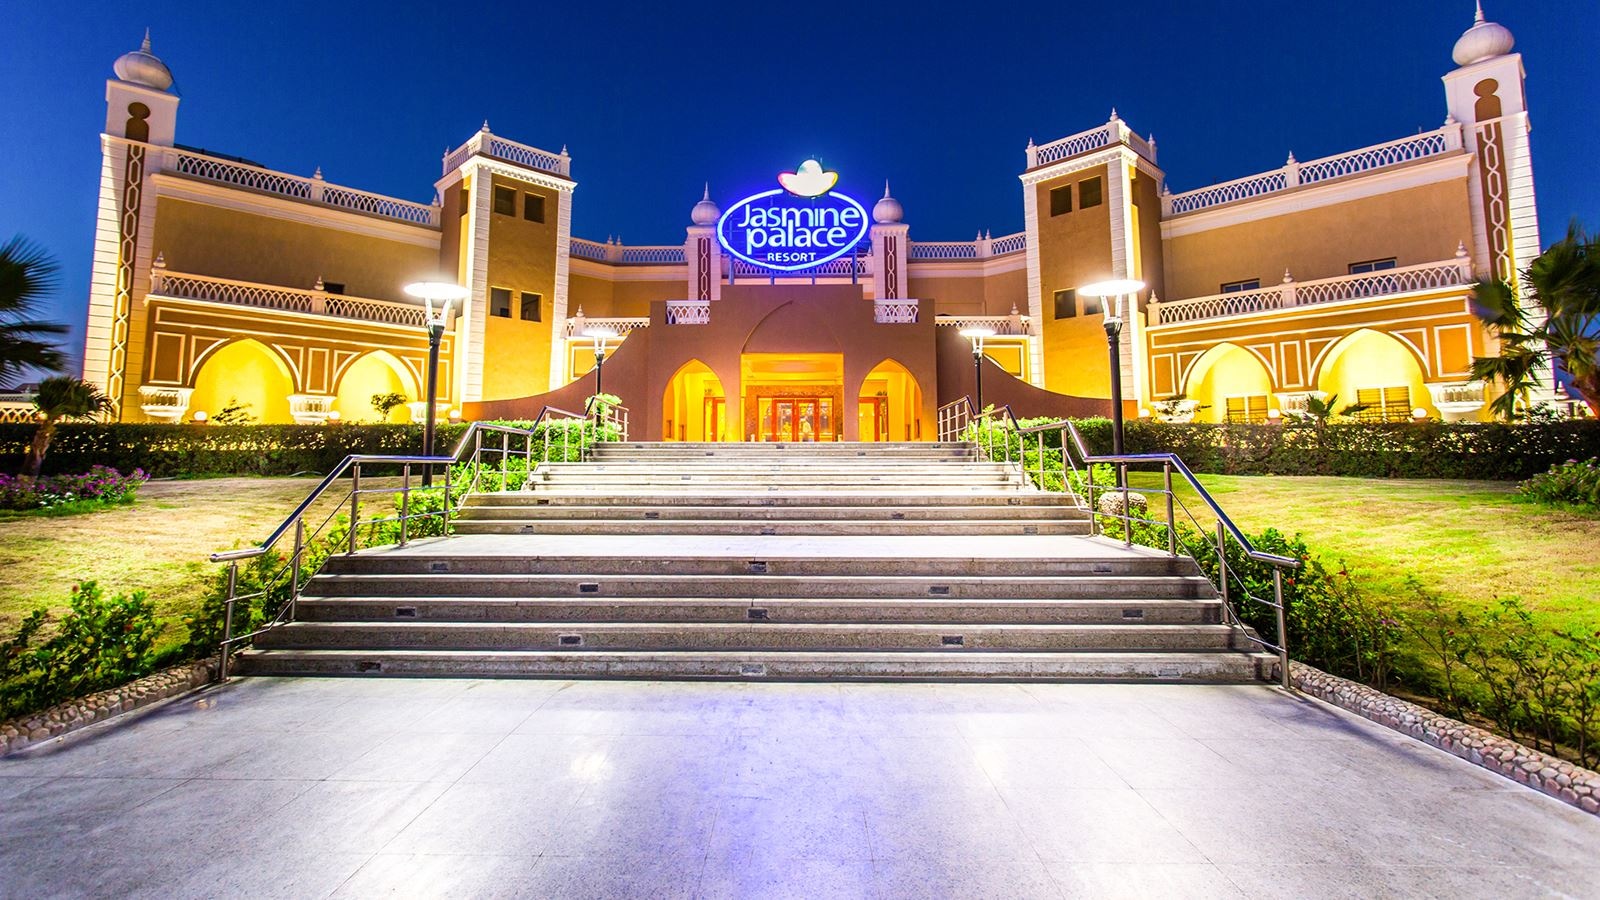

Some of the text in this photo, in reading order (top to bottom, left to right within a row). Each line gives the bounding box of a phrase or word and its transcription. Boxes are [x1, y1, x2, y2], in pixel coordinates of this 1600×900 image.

[738, 204, 861, 228] Jasmine
[746, 219, 847, 255] palace
[767, 252, 816, 262] RESORT
